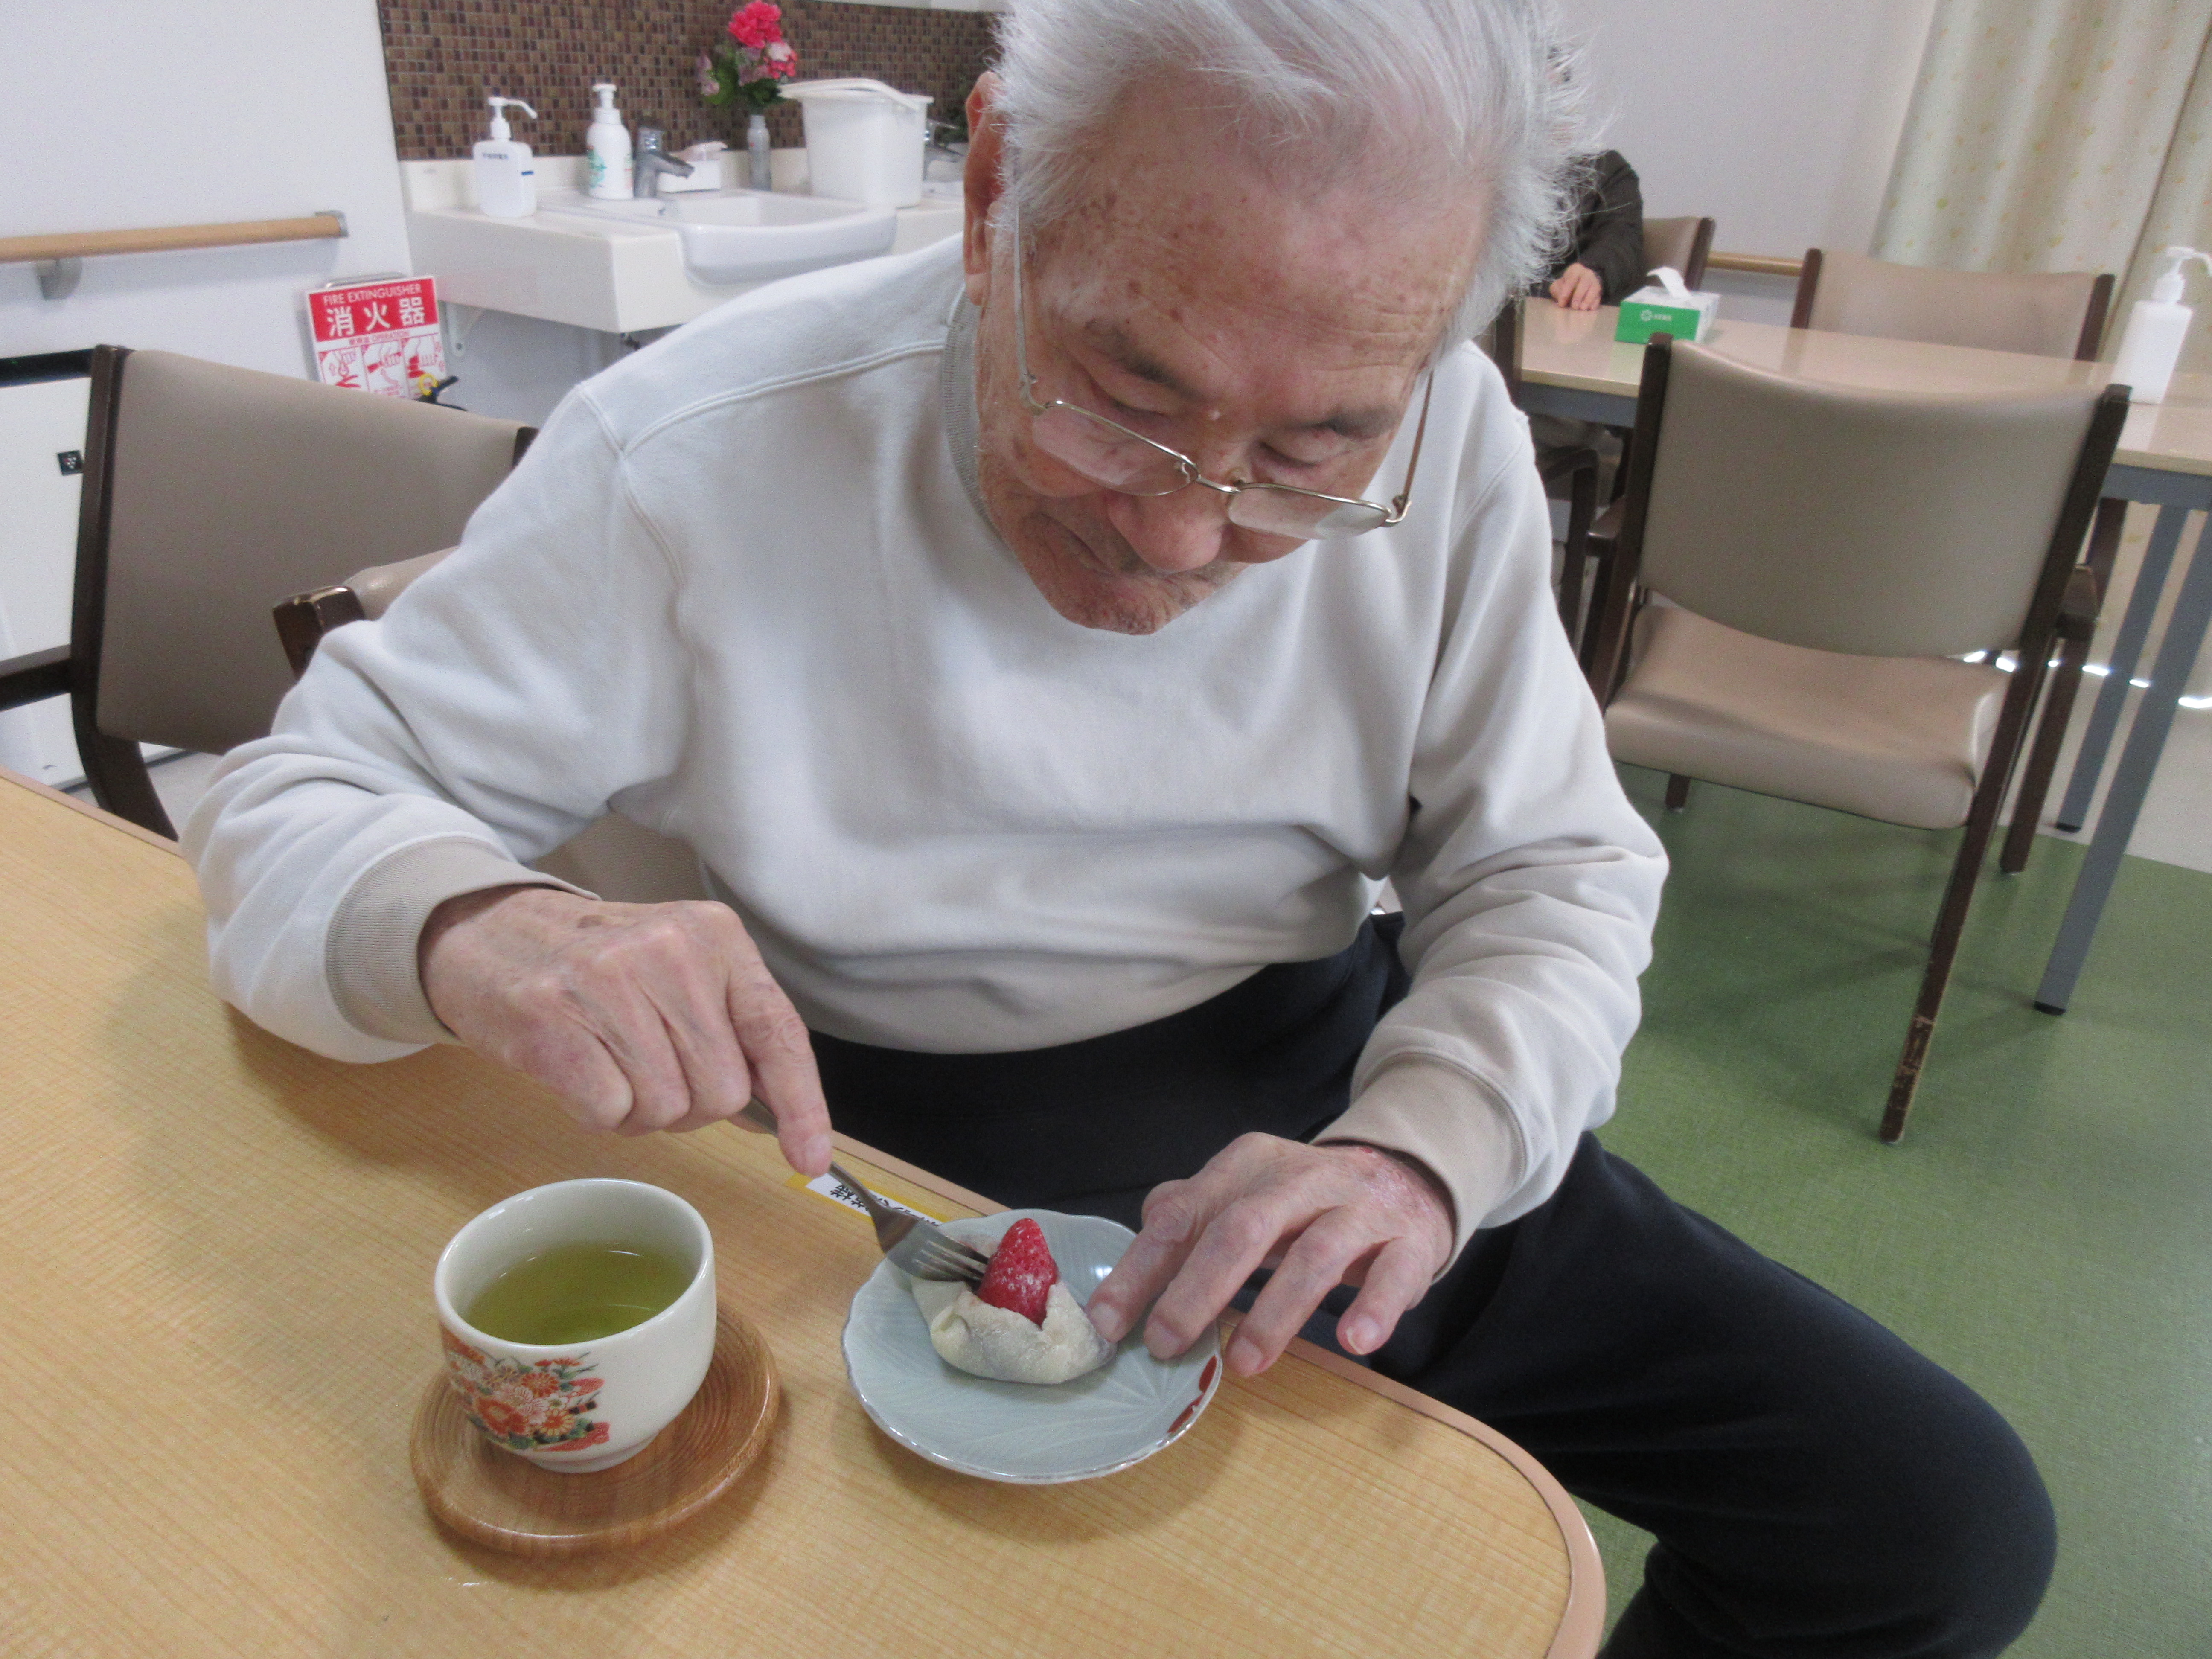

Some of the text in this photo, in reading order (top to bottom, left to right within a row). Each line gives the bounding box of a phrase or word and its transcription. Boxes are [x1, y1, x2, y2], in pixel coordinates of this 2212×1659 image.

[323, 284, 422, 305] FIRE EXTINGUISHER
[326, 296, 425, 337] 消火器
